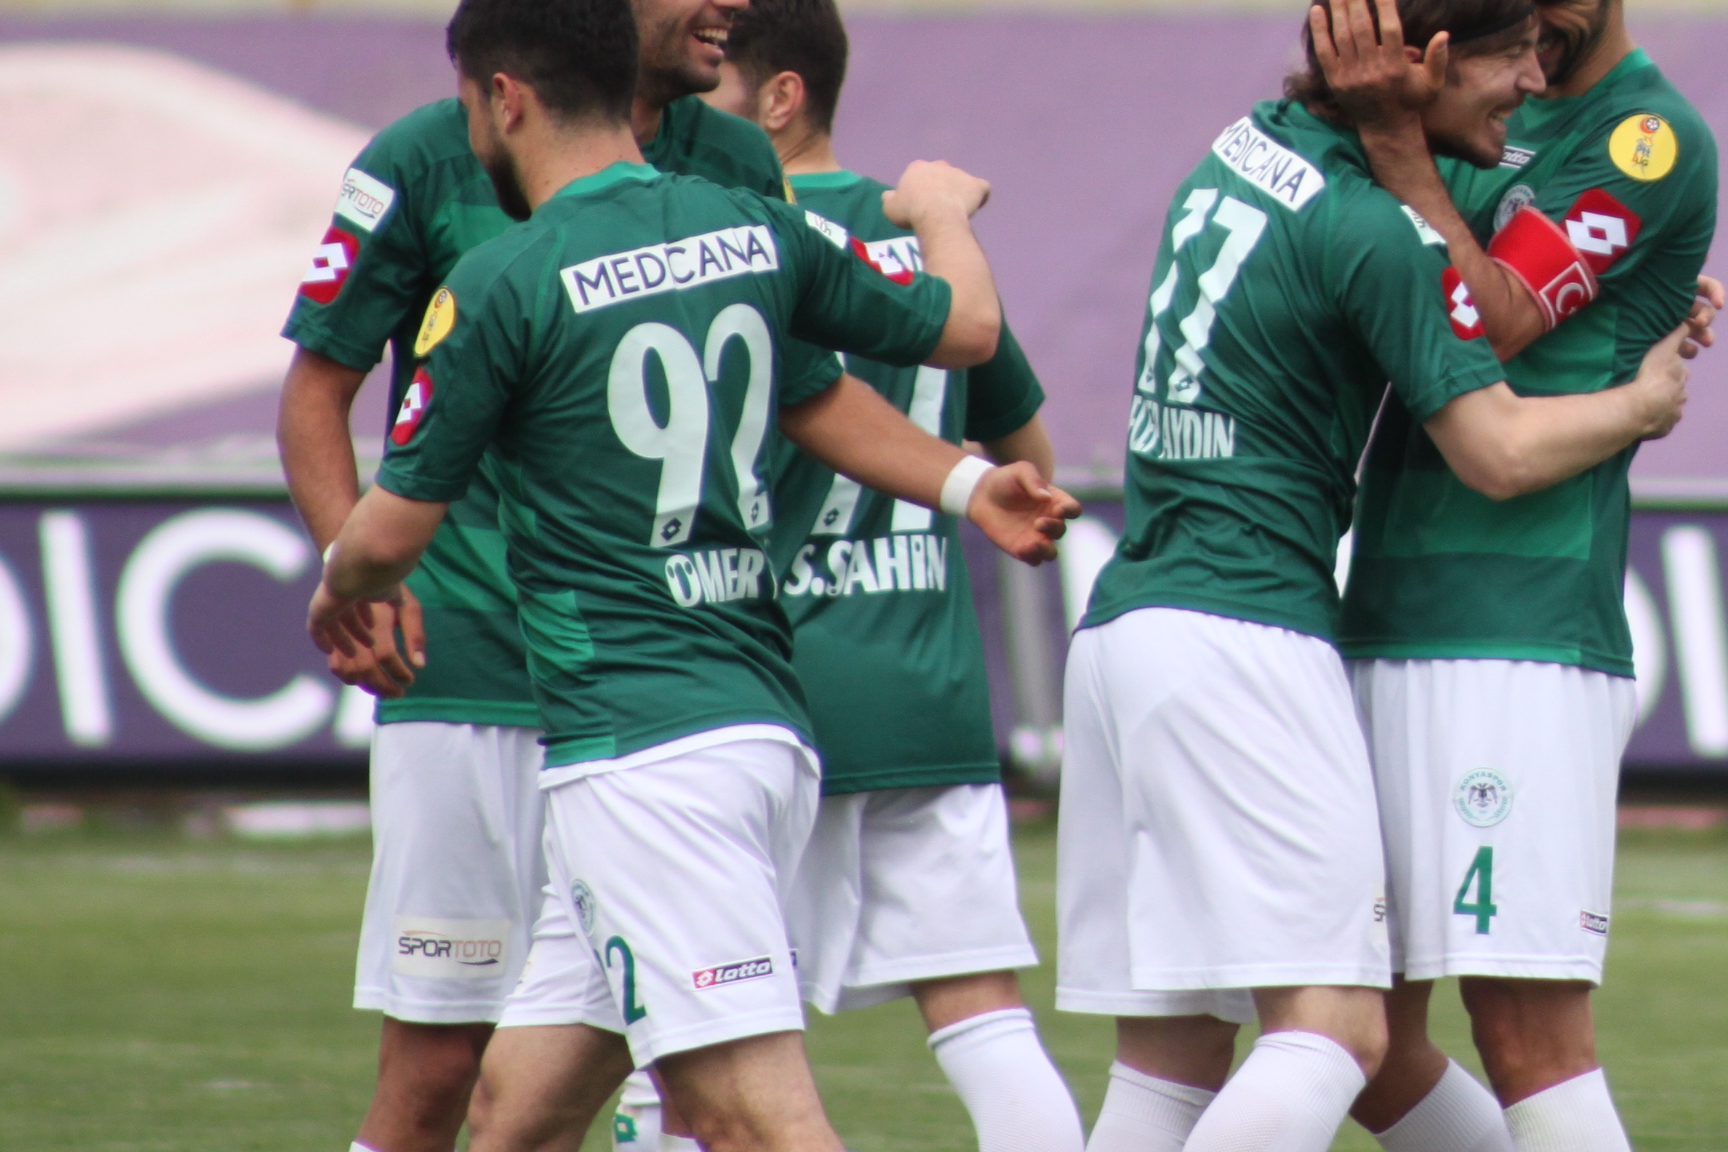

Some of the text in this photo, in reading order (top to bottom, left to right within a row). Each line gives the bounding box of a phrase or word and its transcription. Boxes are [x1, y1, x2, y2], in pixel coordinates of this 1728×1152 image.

[572, 229, 772, 306] MEDCANA
[607, 304, 773, 548] 92
[665, 548, 765, 608] ÖMER
[1453, 845, 1497, 935] 4
[600, 935, 648, 1026] 2
[715, 961, 771, 983] lotto
